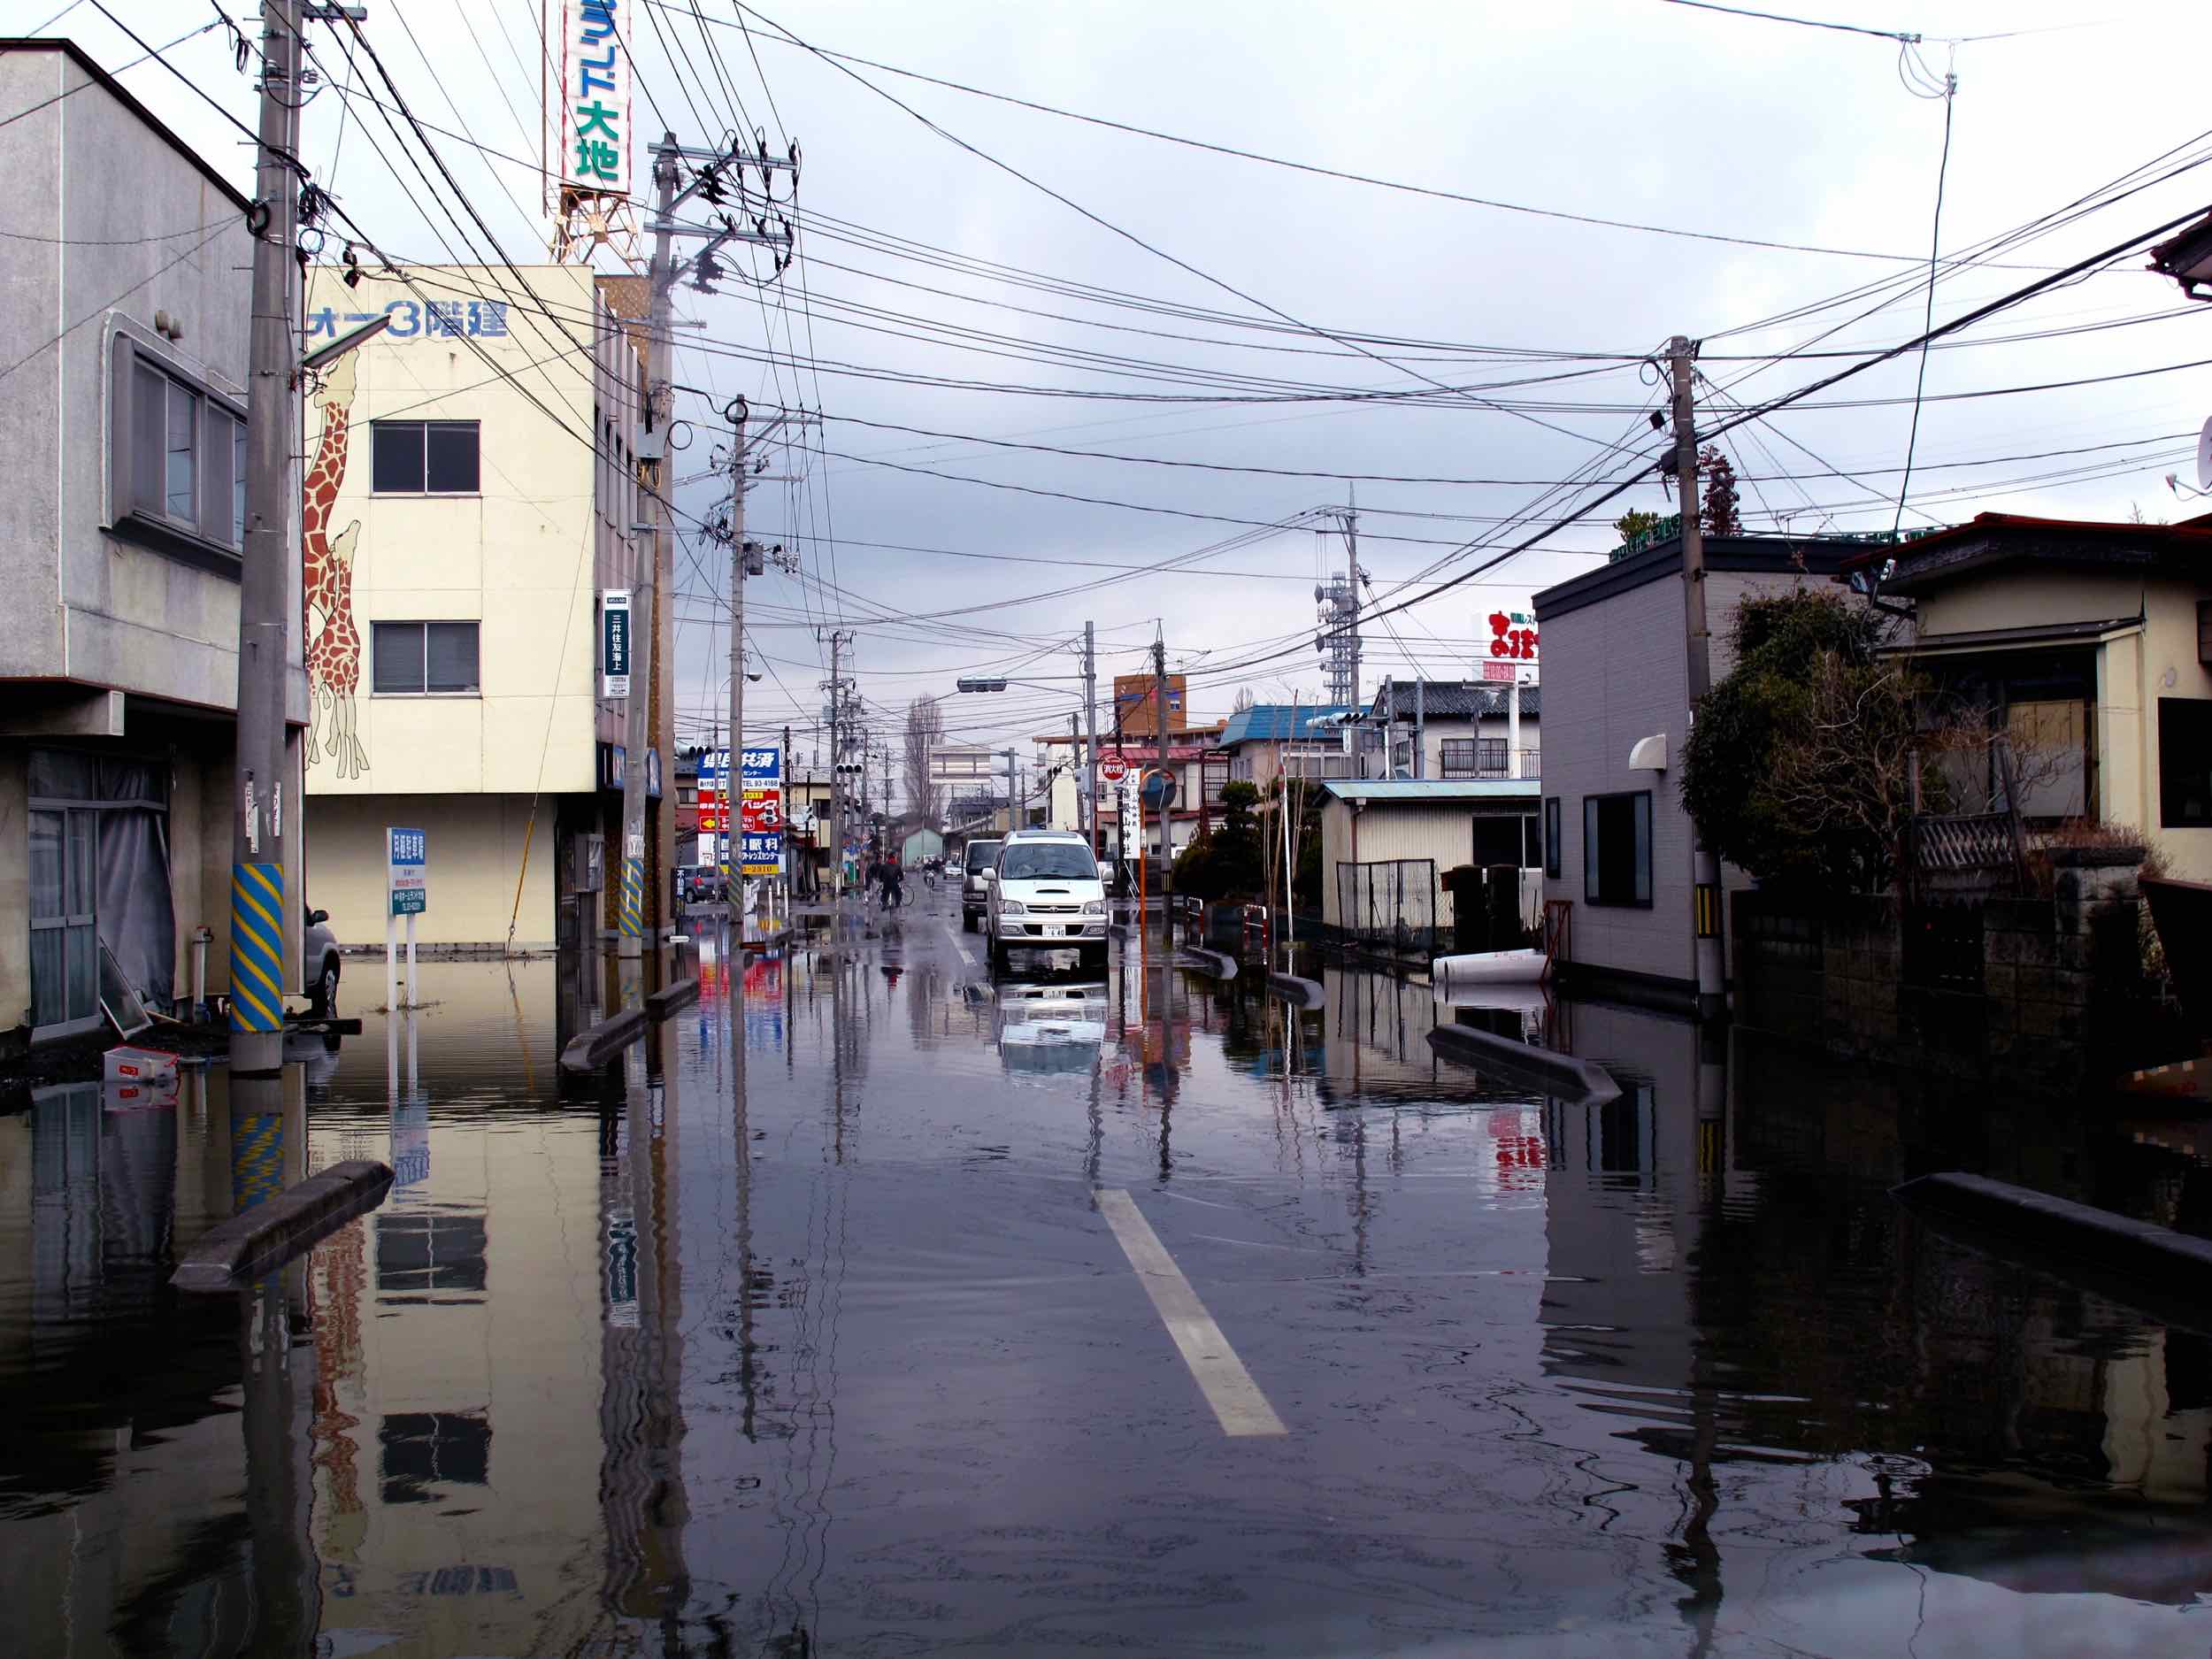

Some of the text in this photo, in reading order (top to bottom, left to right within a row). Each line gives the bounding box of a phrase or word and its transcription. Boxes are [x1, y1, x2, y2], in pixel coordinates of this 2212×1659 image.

[576, 0, 618, 181] ランド大地
[612, 615, 622, 671] 三井住友海上
[1488, 611, 1540, 659] まるま
[1103, 765, 1125, 774] 消火栓
